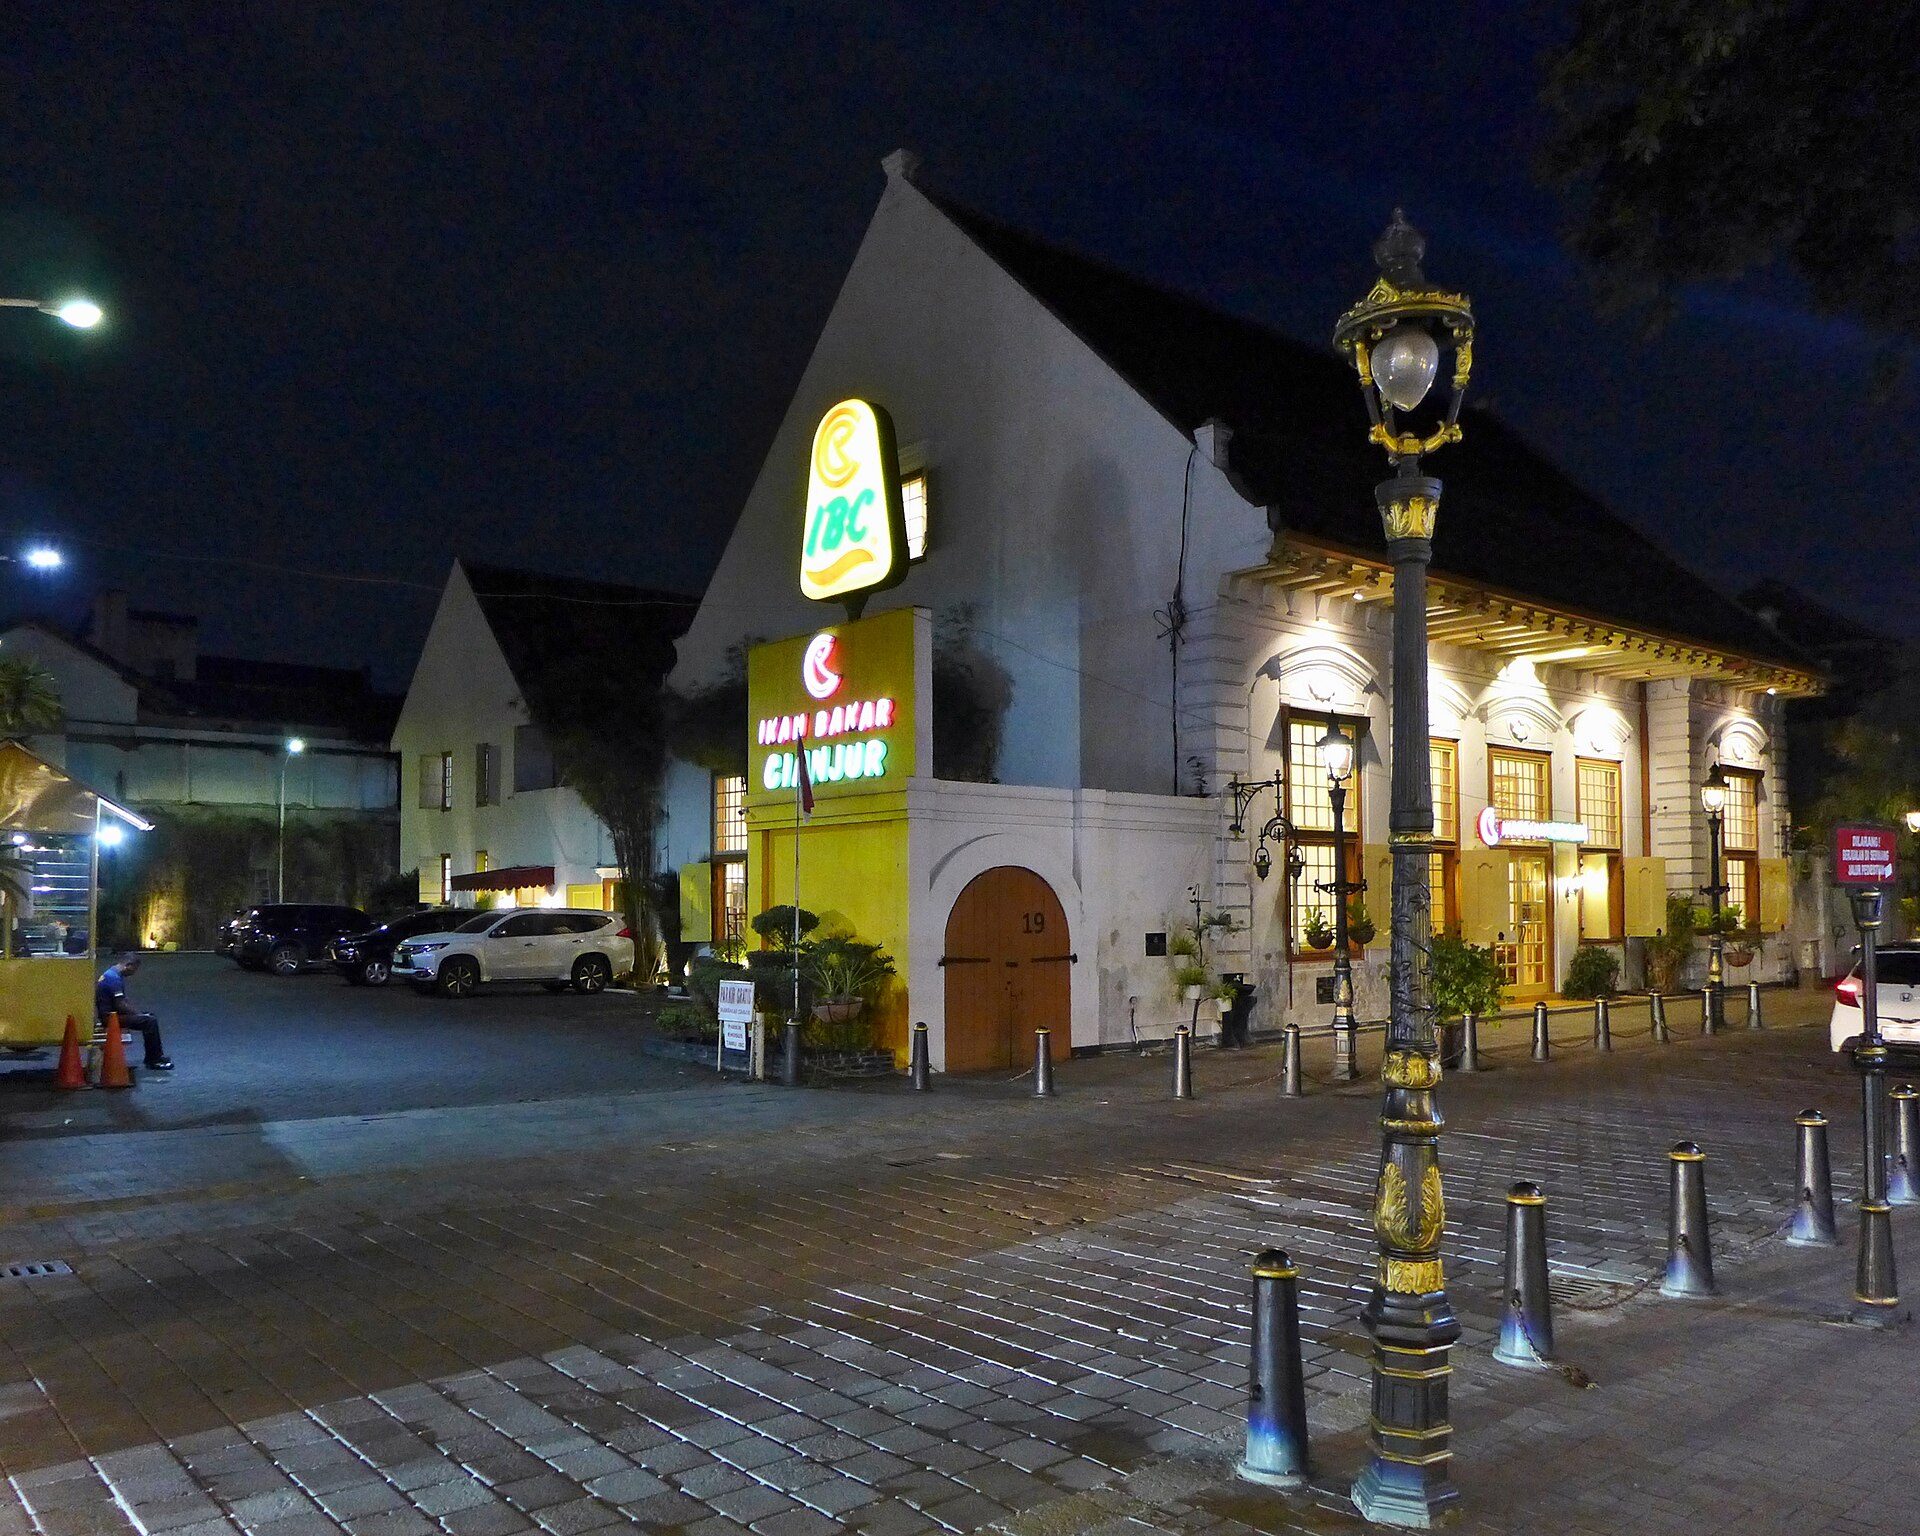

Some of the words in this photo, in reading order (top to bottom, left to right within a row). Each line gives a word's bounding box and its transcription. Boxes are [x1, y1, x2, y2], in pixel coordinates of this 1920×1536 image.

[806, 488, 875, 558] IBC
[758, 712, 810, 746] IKAN
[814, 698, 894, 738] BAKAR
[1022, 912, 1045, 934] 19
